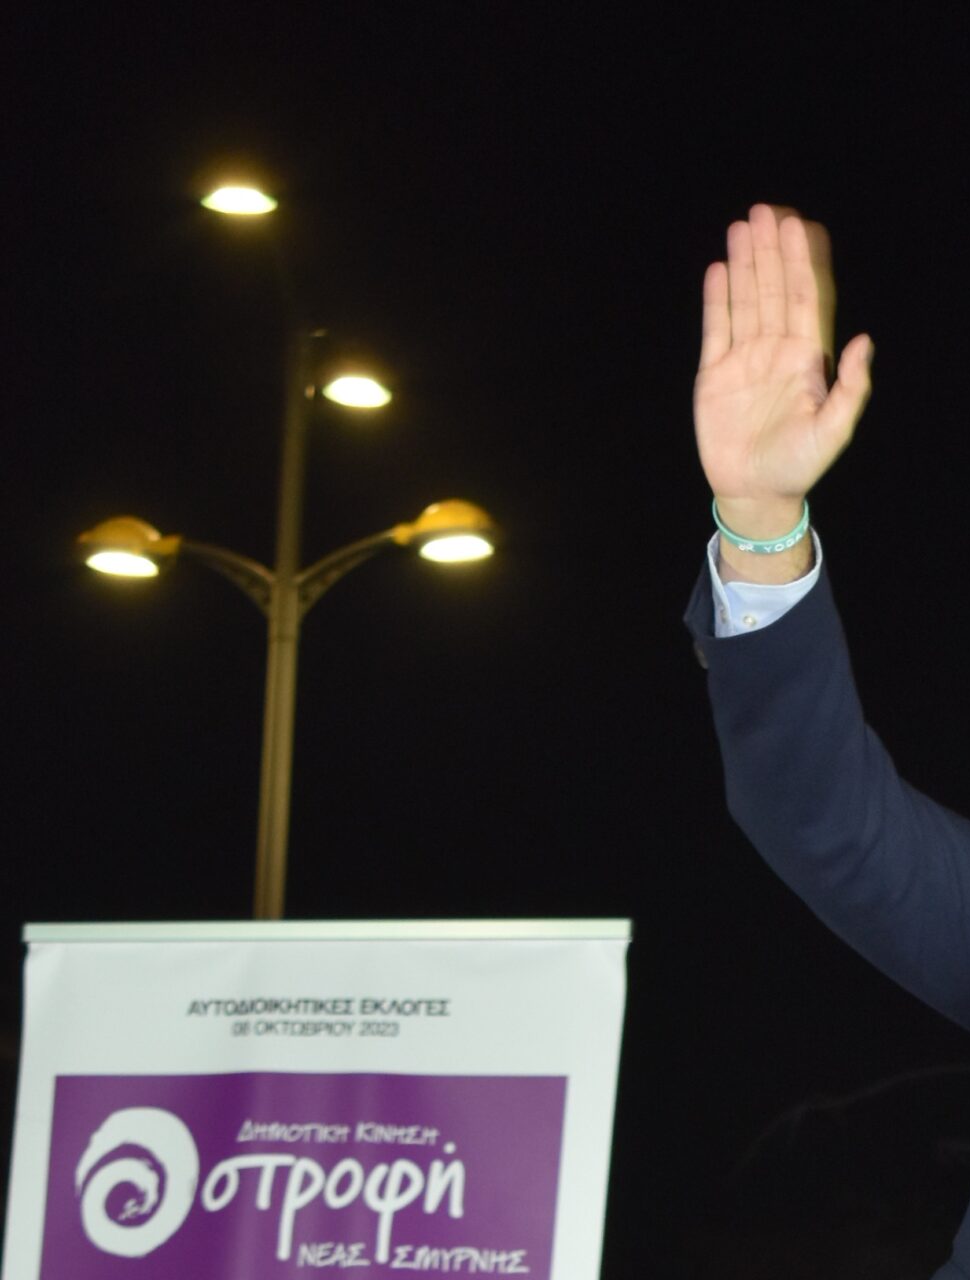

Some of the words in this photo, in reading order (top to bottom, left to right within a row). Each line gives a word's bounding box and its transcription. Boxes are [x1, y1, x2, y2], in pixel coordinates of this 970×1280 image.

[187, 998, 354, 1017] ΑΥΤΟΔΙΟΙΚΗΤΙΚΕΣ
[359, 998, 451, 1018] ΕΚΛΟΓΕΣ
[236, 1120, 351, 1143] ΔΗΜΟΤΙΚΗ
[354, 1122, 440, 1146] ΚΙΝΗΣΗ
[202, 1141, 466, 1265] στροφή
[297, 1242, 371, 1268] ΝΕΑΣ
[390, 1245, 530, 1274] ΣΜΥΡΝΗΣ
